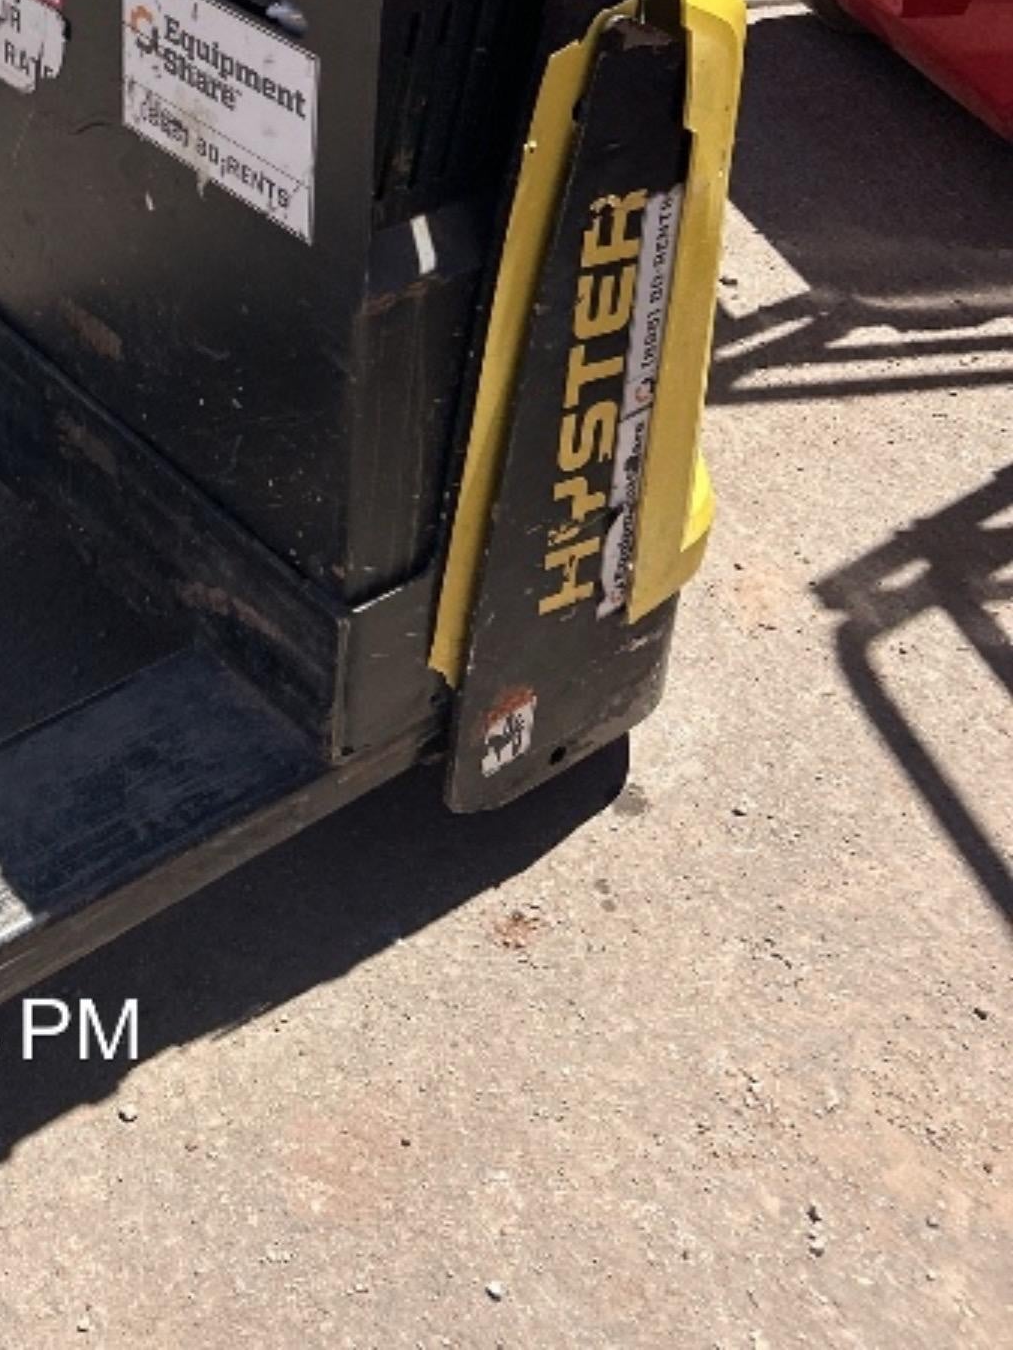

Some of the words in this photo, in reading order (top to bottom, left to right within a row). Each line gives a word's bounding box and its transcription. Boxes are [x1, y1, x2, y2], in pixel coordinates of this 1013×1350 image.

[163, 14, 307, 121] Equipment
[163, 47, 237, 112] Share
[537, 187, 649, 616] HYSTER
